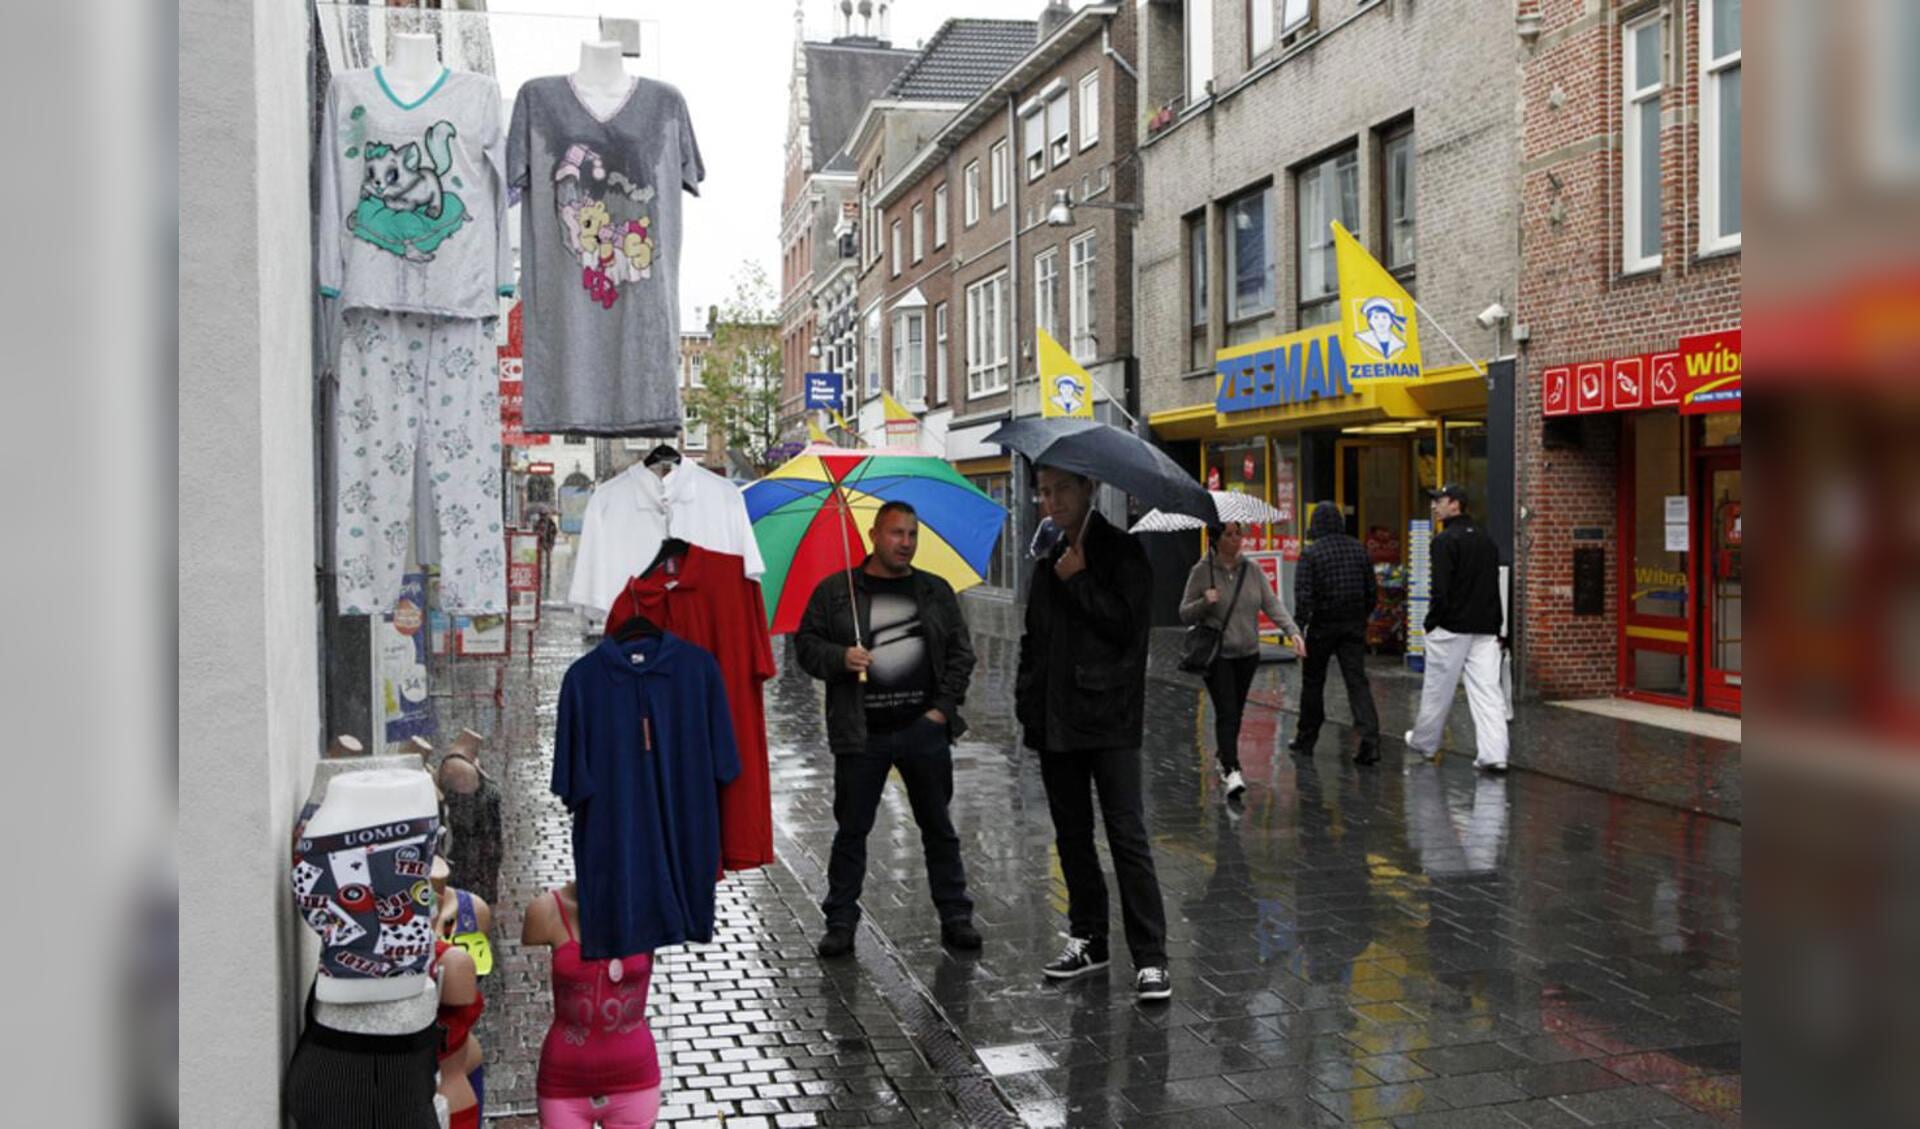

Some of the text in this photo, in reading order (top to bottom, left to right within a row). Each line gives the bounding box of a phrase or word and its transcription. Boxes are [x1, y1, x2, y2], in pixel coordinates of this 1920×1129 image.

[1350, 363, 1420, 378] ZEEMAN
[1685, 342, 1741, 377] Wib
[1216, 335, 1353, 413] ZEEMAN
[1635, 564, 1688, 586] Wibra
[343, 823, 411, 846] UOMO
[337, 952, 376, 973] FLOP
